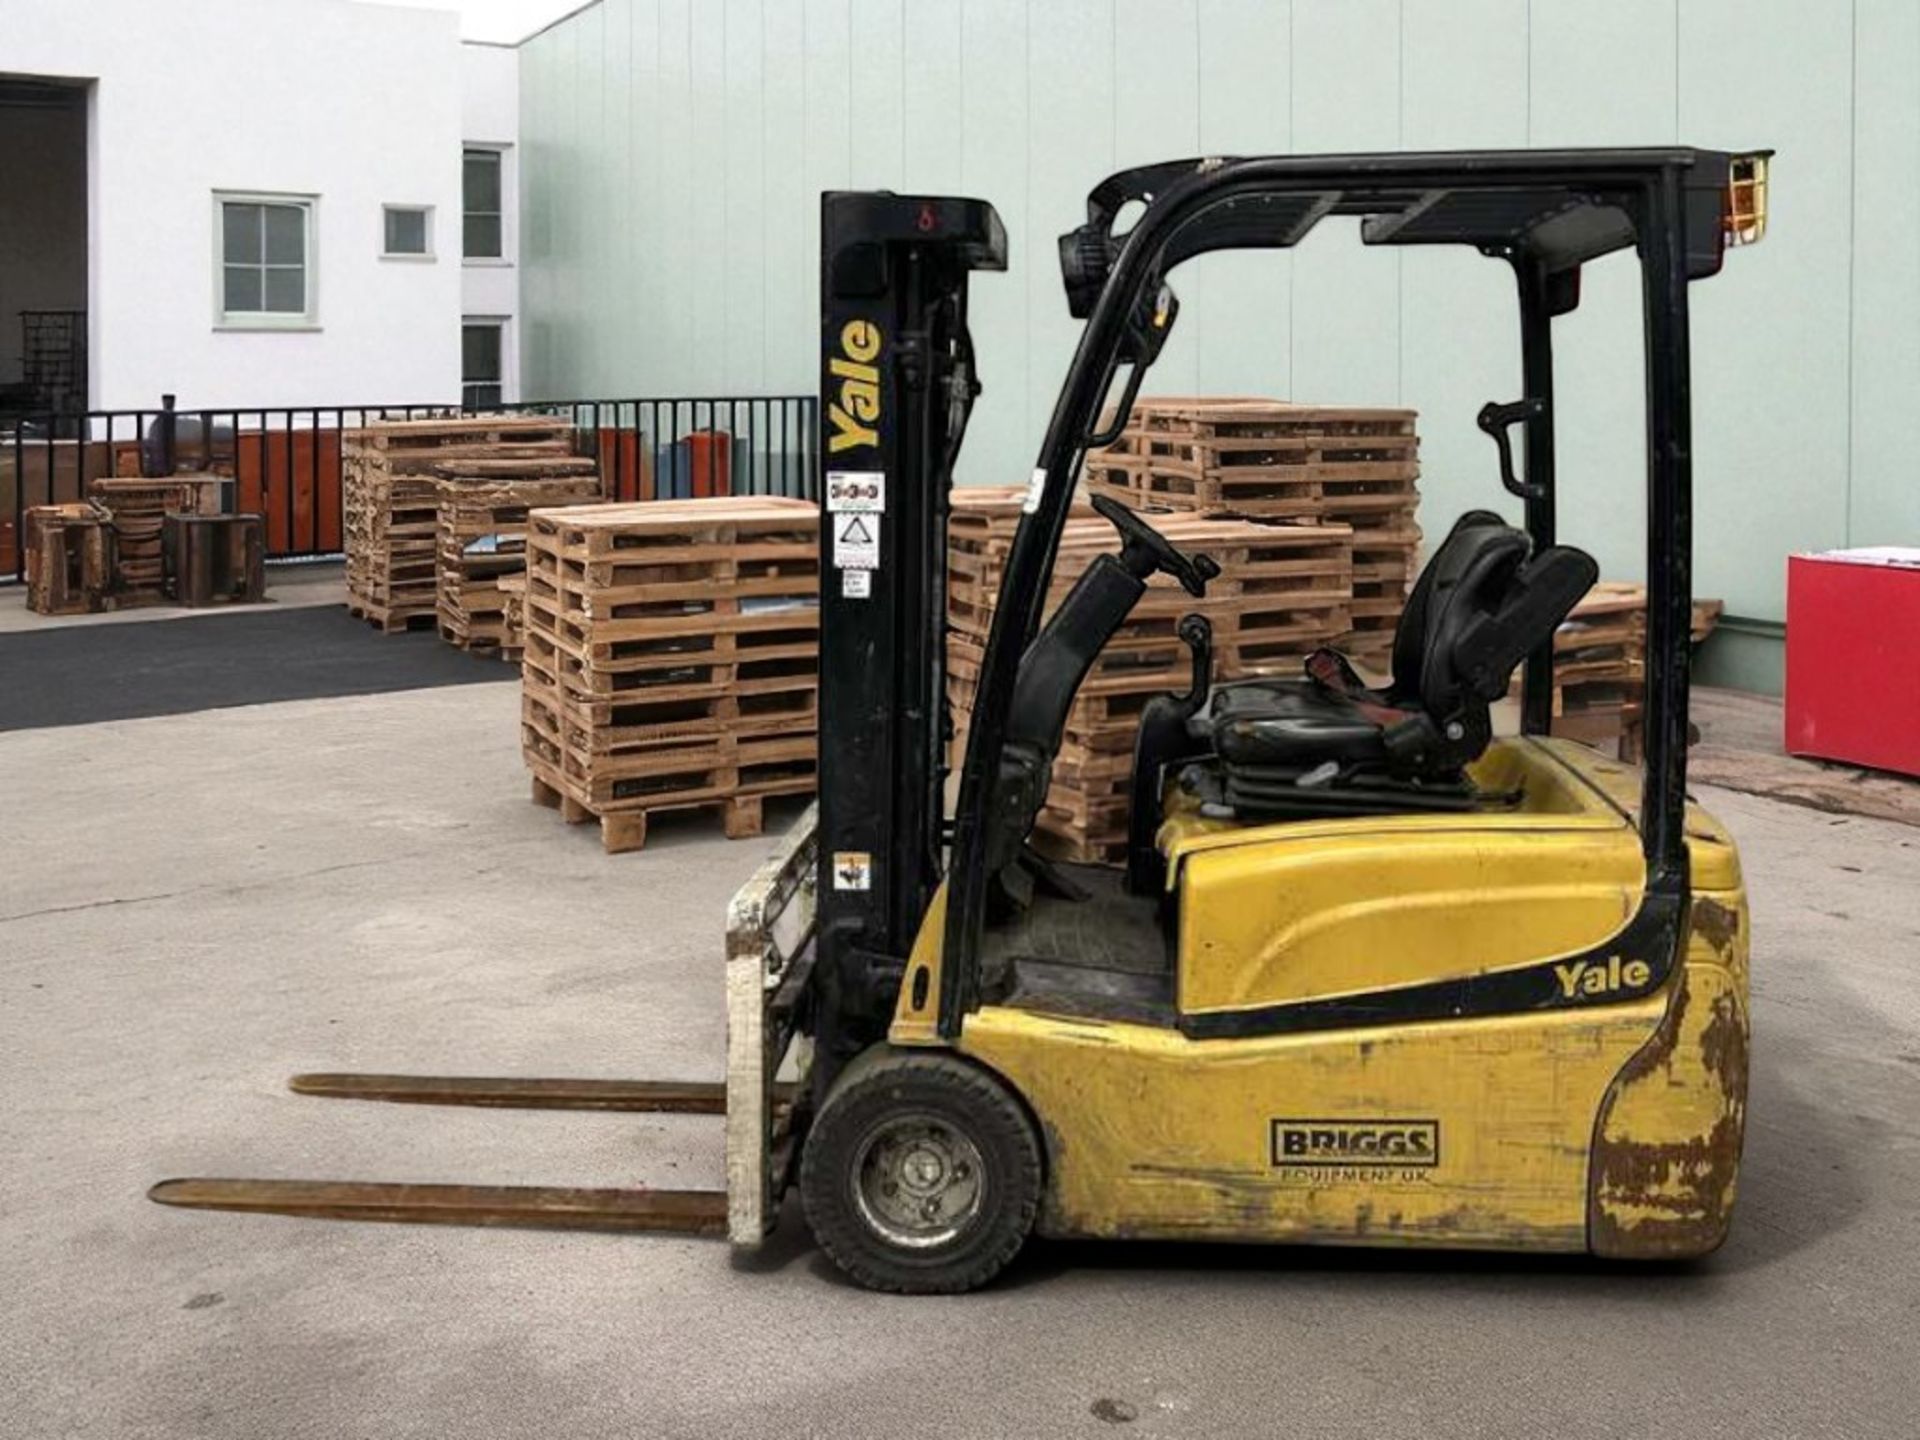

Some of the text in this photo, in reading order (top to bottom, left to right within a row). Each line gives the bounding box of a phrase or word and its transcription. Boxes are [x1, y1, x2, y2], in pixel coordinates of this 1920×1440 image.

[829, 320, 880, 452] Yale
[1554, 955, 1650, 997] Yale
[1283, 1130, 1432, 1156] BRIGGS
